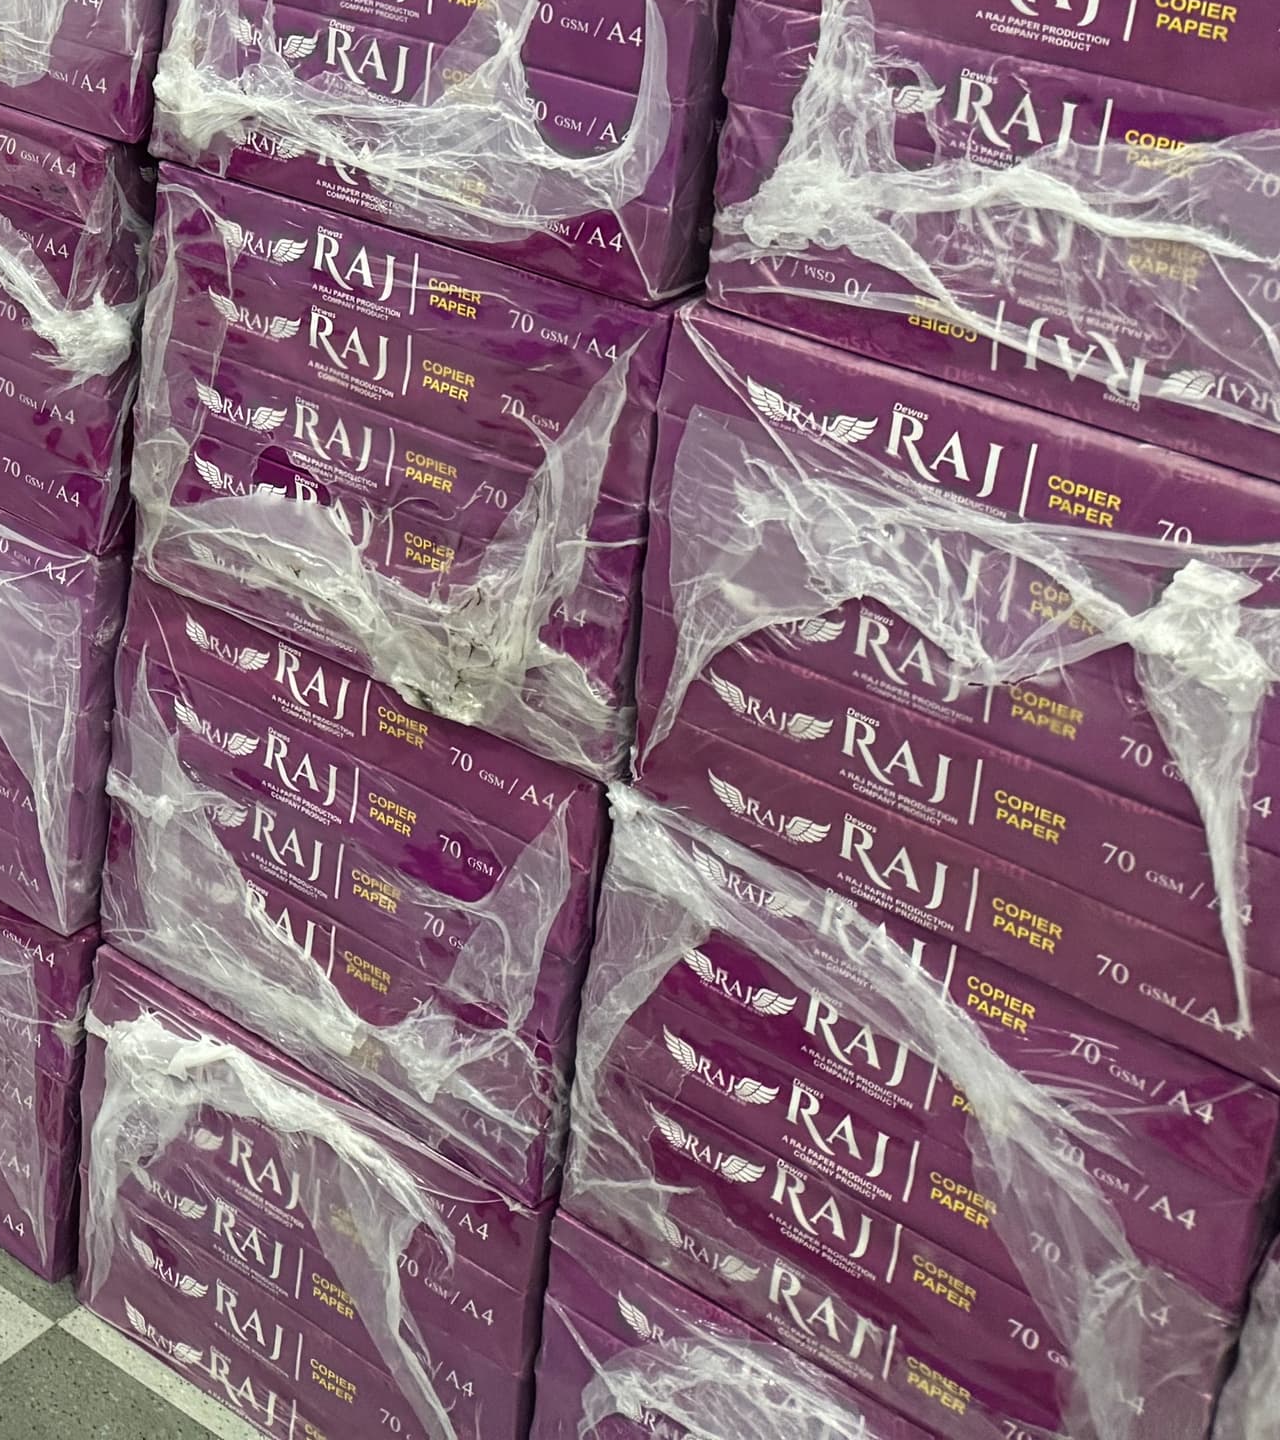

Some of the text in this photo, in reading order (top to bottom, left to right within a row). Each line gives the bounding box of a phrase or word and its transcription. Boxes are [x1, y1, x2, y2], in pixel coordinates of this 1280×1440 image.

[1155, 13, 1229, 42] PAPER
[313, 231, 396, 302] RAJ
[428, 277, 482, 305] COPIER
[429, 295, 478, 320] PAPER
[508, 309, 570, 346] 70 GSM
[2, 458, 21, 478] 70
[886, 411, 1004, 499] RAJ
[1047, 474, 1122, 512] COPIER
[1048, 495, 1115, 528] PAPER
[276, 649, 351, 720] RAJ
[377, 704, 429, 736] COPIER
[378, 720, 425, 750] PAPER
[448, 746, 474, 774] 70
[839, 819, 950, 910] RAJ
[991, 896, 1063, 940] COPIER
[992, 916, 1056, 955] PAPER
